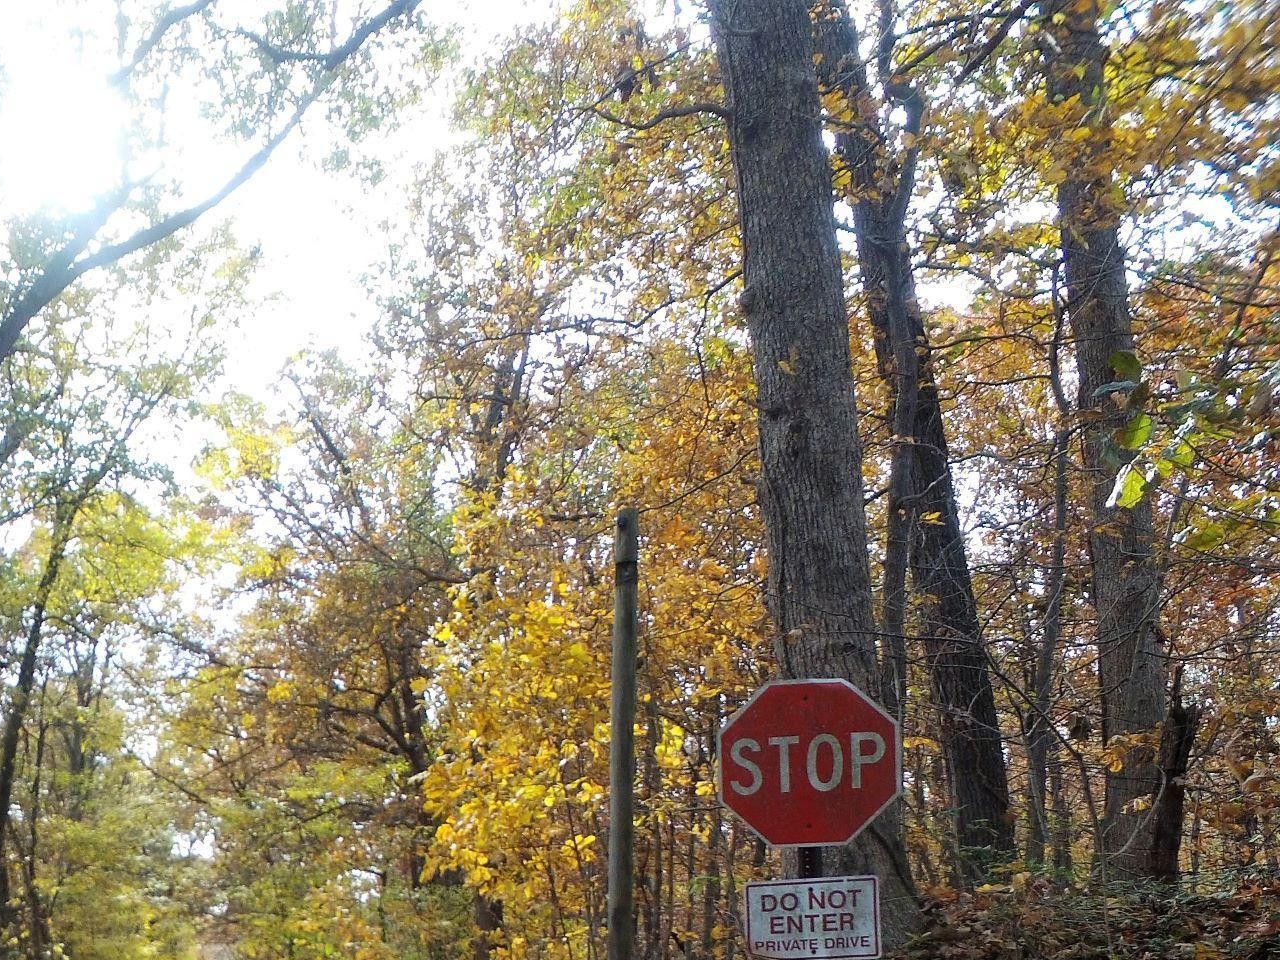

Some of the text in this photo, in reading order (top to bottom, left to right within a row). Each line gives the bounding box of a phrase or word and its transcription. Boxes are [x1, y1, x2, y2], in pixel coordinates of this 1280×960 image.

[730, 732, 886, 796] STOP
[760, 889, 862, 912] DO NOT
[770, 912, 854, 935] ENTER
[755, 935, 870, 952] PRIVATE DRIVE
